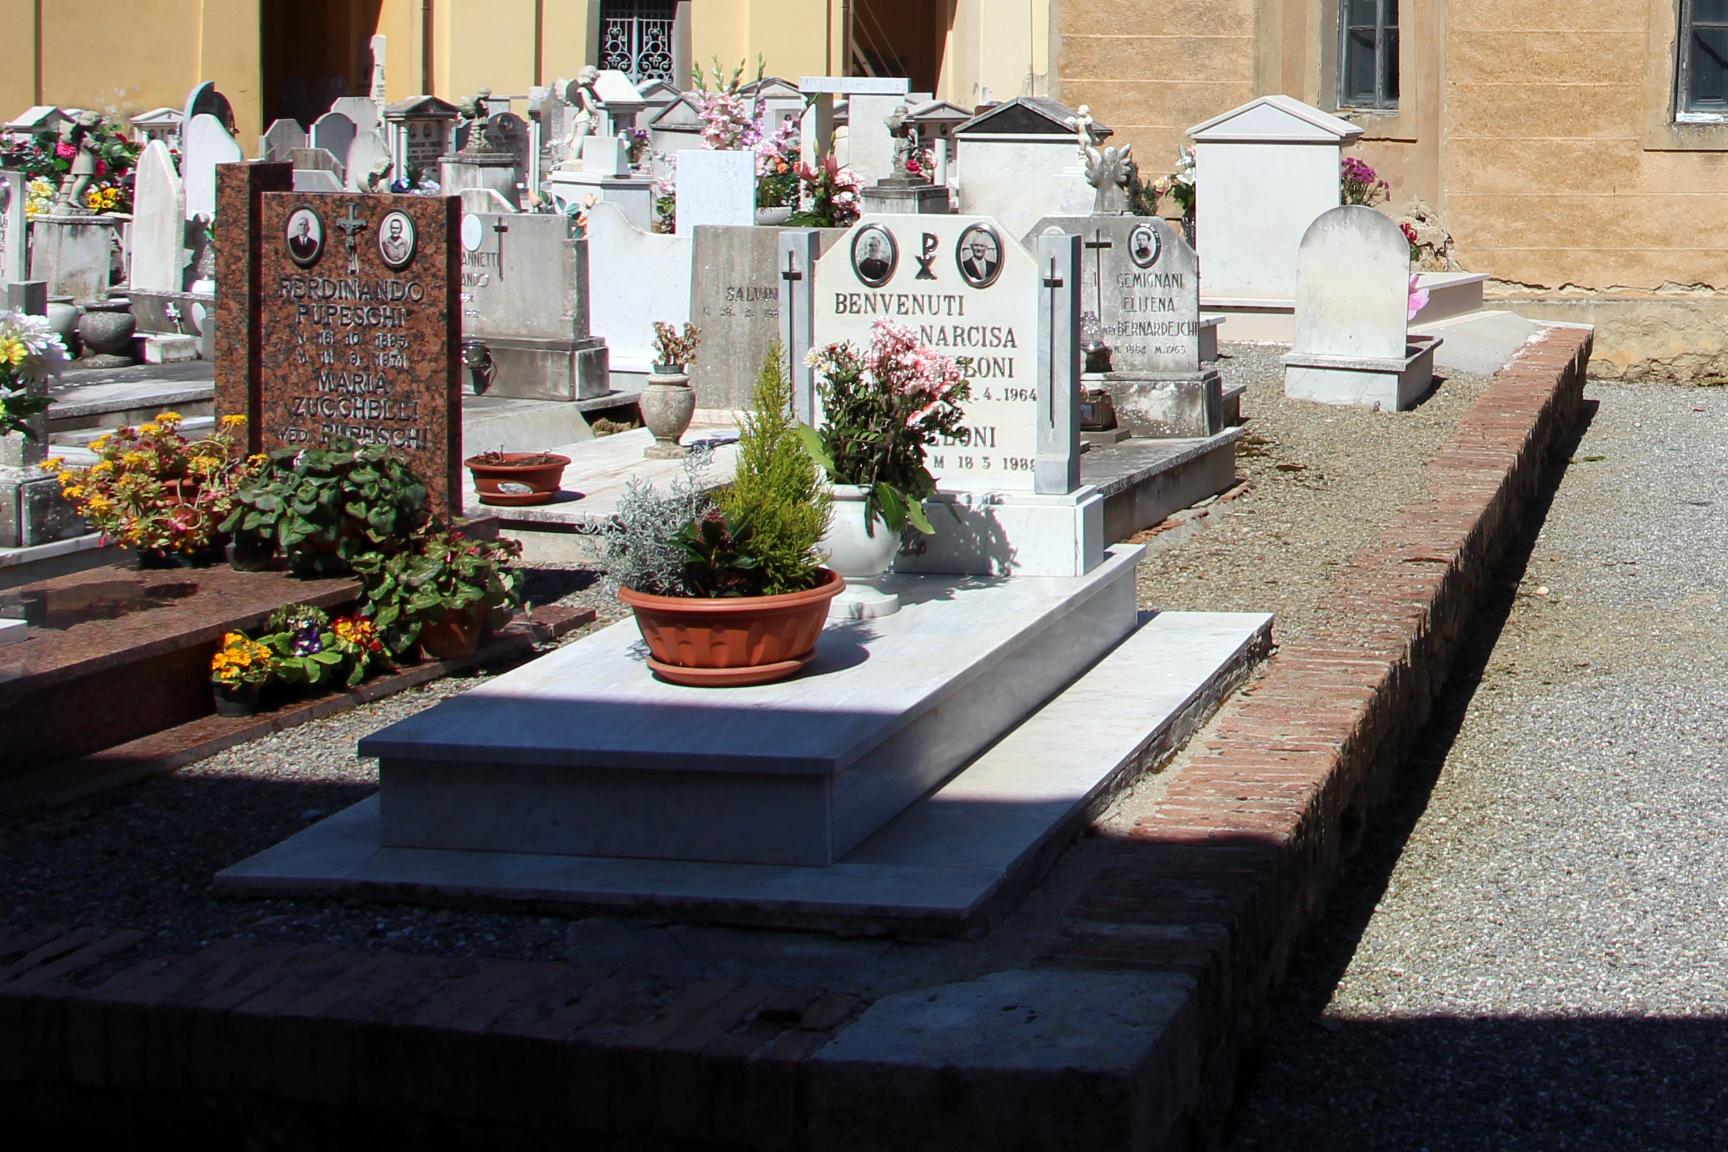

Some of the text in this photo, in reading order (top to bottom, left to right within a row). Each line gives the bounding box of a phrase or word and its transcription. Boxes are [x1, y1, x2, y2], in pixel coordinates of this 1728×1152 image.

[279, 278, 425, 302] FERDINANDO
[1117, 273, 1184, 289] GEMIGNANI
[296, 304, 406, 328] PUPESCHI
[835, 293, 965, 316] BENVENUTI
[920, 325, 1018, 349] NARCISA
[317, 371, 390, 395] MARIA
[292, 397, 419, 421] ZUCCHELLI
